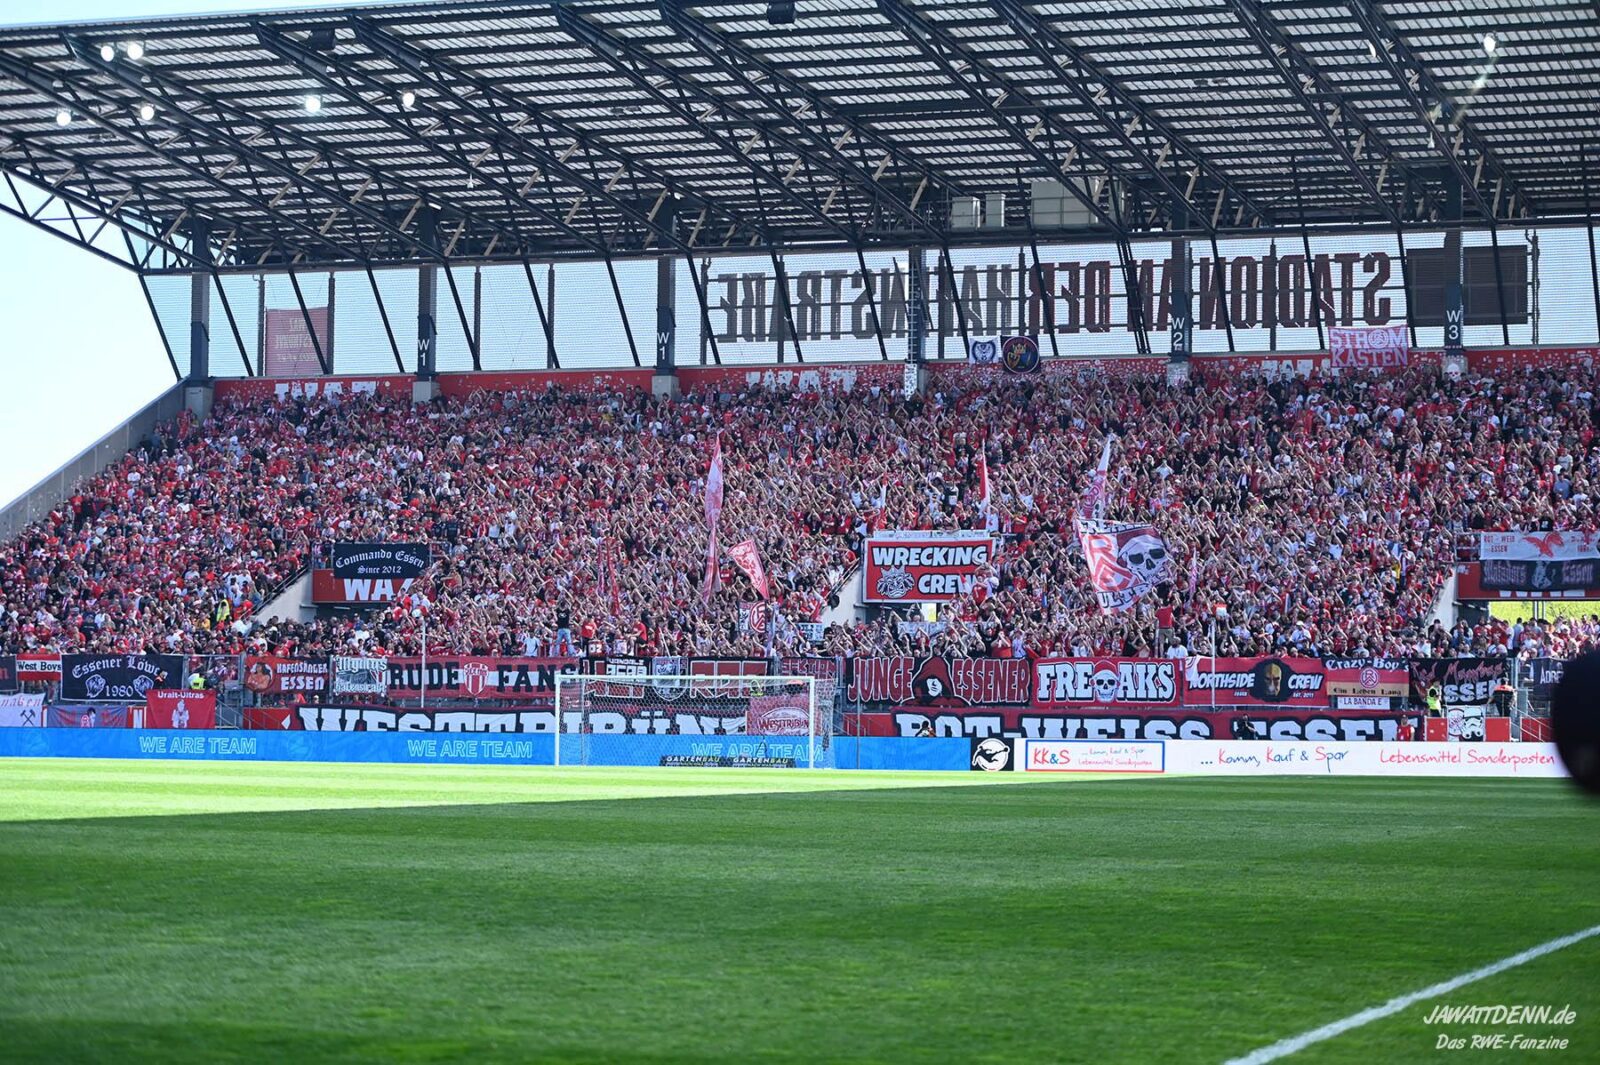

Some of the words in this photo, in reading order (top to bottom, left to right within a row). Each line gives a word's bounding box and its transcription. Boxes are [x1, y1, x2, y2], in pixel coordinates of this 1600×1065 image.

[1171, 317, 1185, 330] W
[1446, 310, 1460, 322] W
[657, 332, 669, 344] W
[1173, 332, 1183, 347] 2
[1449, 325, 1459, 339] 3
[418, 339, 430, 350] W
[659, 346, 666, 360] 1
[1330, 347, 1408, 367] KASTEN
[336, 549, 392, 568] Commando
[395, 550, 425, 568] Essen
[872, 546, 988, 566] WRECKING
[357, 565, 380, 574] Since
[382, 565, 402, 574] 2012
[17, 661, 38, 671] West
[40, 661, 62, 671] Boys
[72, 656, 122, 679] Essener
[127, 655, 160, 676] Löwe
[281, 676, 325, 691] ESSEN
[390, 661, 460, 691] RUDE
[496, 663, 578, 693] FANS
[848, 657, 914, 702] JUNGE
[953, 659, 1031, 702] ESSENER
[1189, 673, 1256, 688] NORTHSIDE
[1288, 674, 1323, 690] CREW
[106, 685, 133, 697] 1980
[158, 690, 204, 699] Uralt-Ultras
[1353, 697, 1377, 706] BANDA
[139, 737, 166, 753] WE
[169, 738, 205, 754] ARE
[208, 738, 257, 755] TEAM
[408, 740, 436, 757] WE
[441, 740, 478, 758] ARE
[481, 741, 533, 758] TEAM
[692, 743, 723, 758] WE
[727, 743, 767, 759] ARE
[770, 743, 824, 762] TEAM
[1033, 748, 1071, 765] KK&S
[1218, 748, 1261, 766] Komm,
[1266, 747, 1295, 763] Kauf
[1300, 750, 1308, 761] &
[1315, 746, 1349, 773] Spar
[1380, 748, 1462, 765] Lebensmittel
[1467, 747, 1555, 774] Sonderposten
